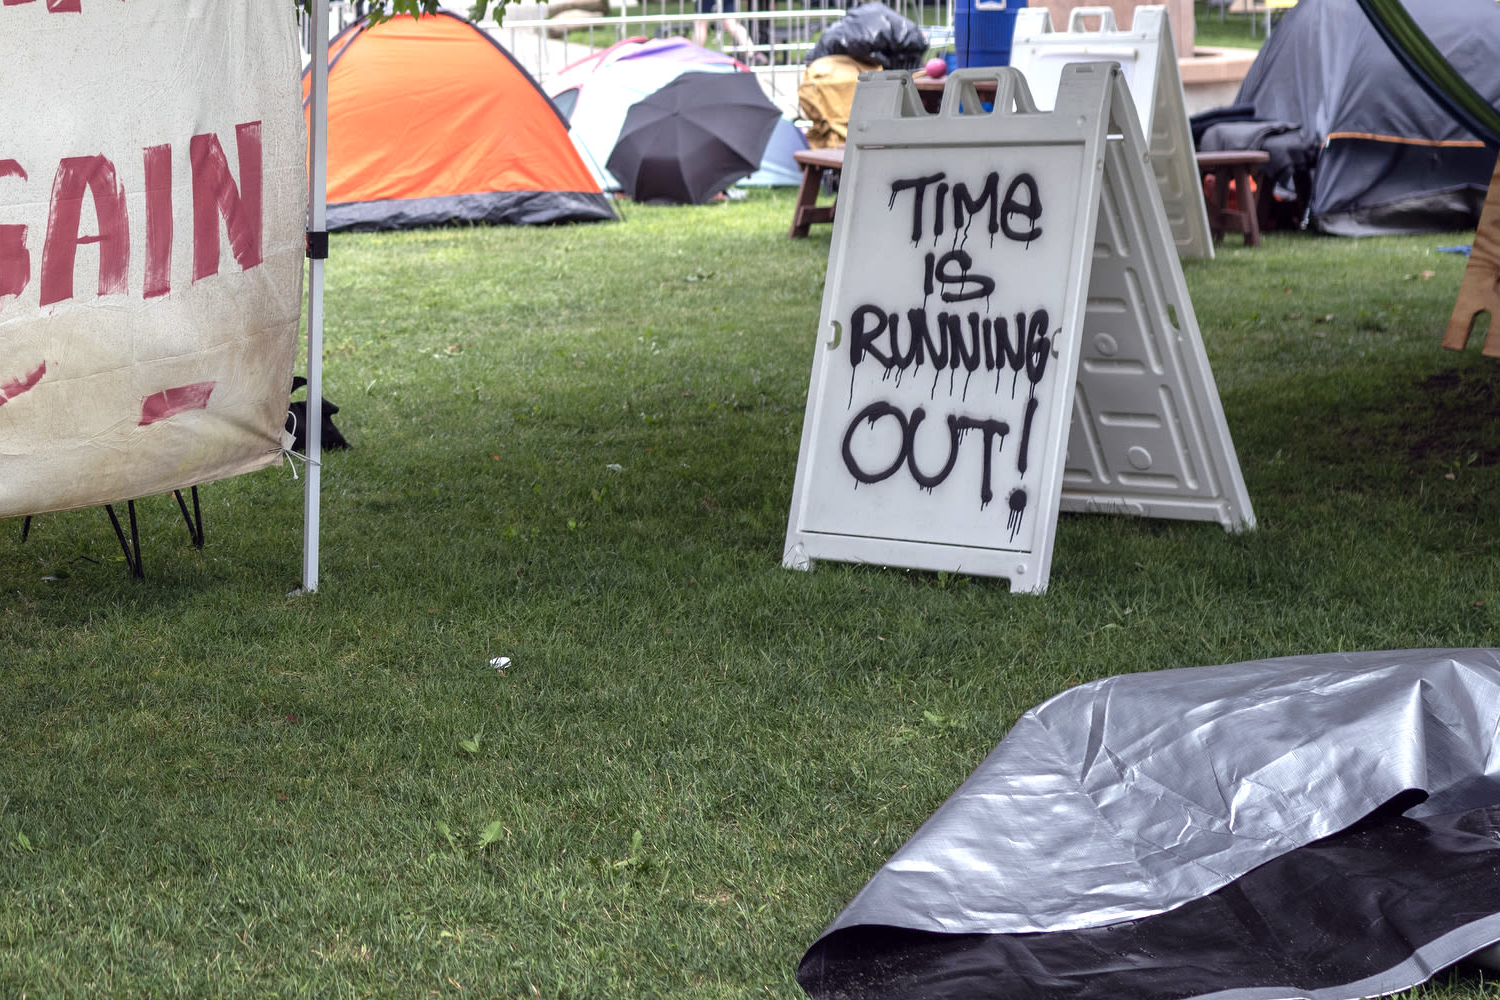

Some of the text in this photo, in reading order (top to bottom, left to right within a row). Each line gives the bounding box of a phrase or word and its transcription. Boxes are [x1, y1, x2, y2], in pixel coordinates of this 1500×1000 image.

[924, 249, 996, 305] IS
[849, 303, 1051, 387] RUNNING
[841, 399, 1039, 520] OUT!
